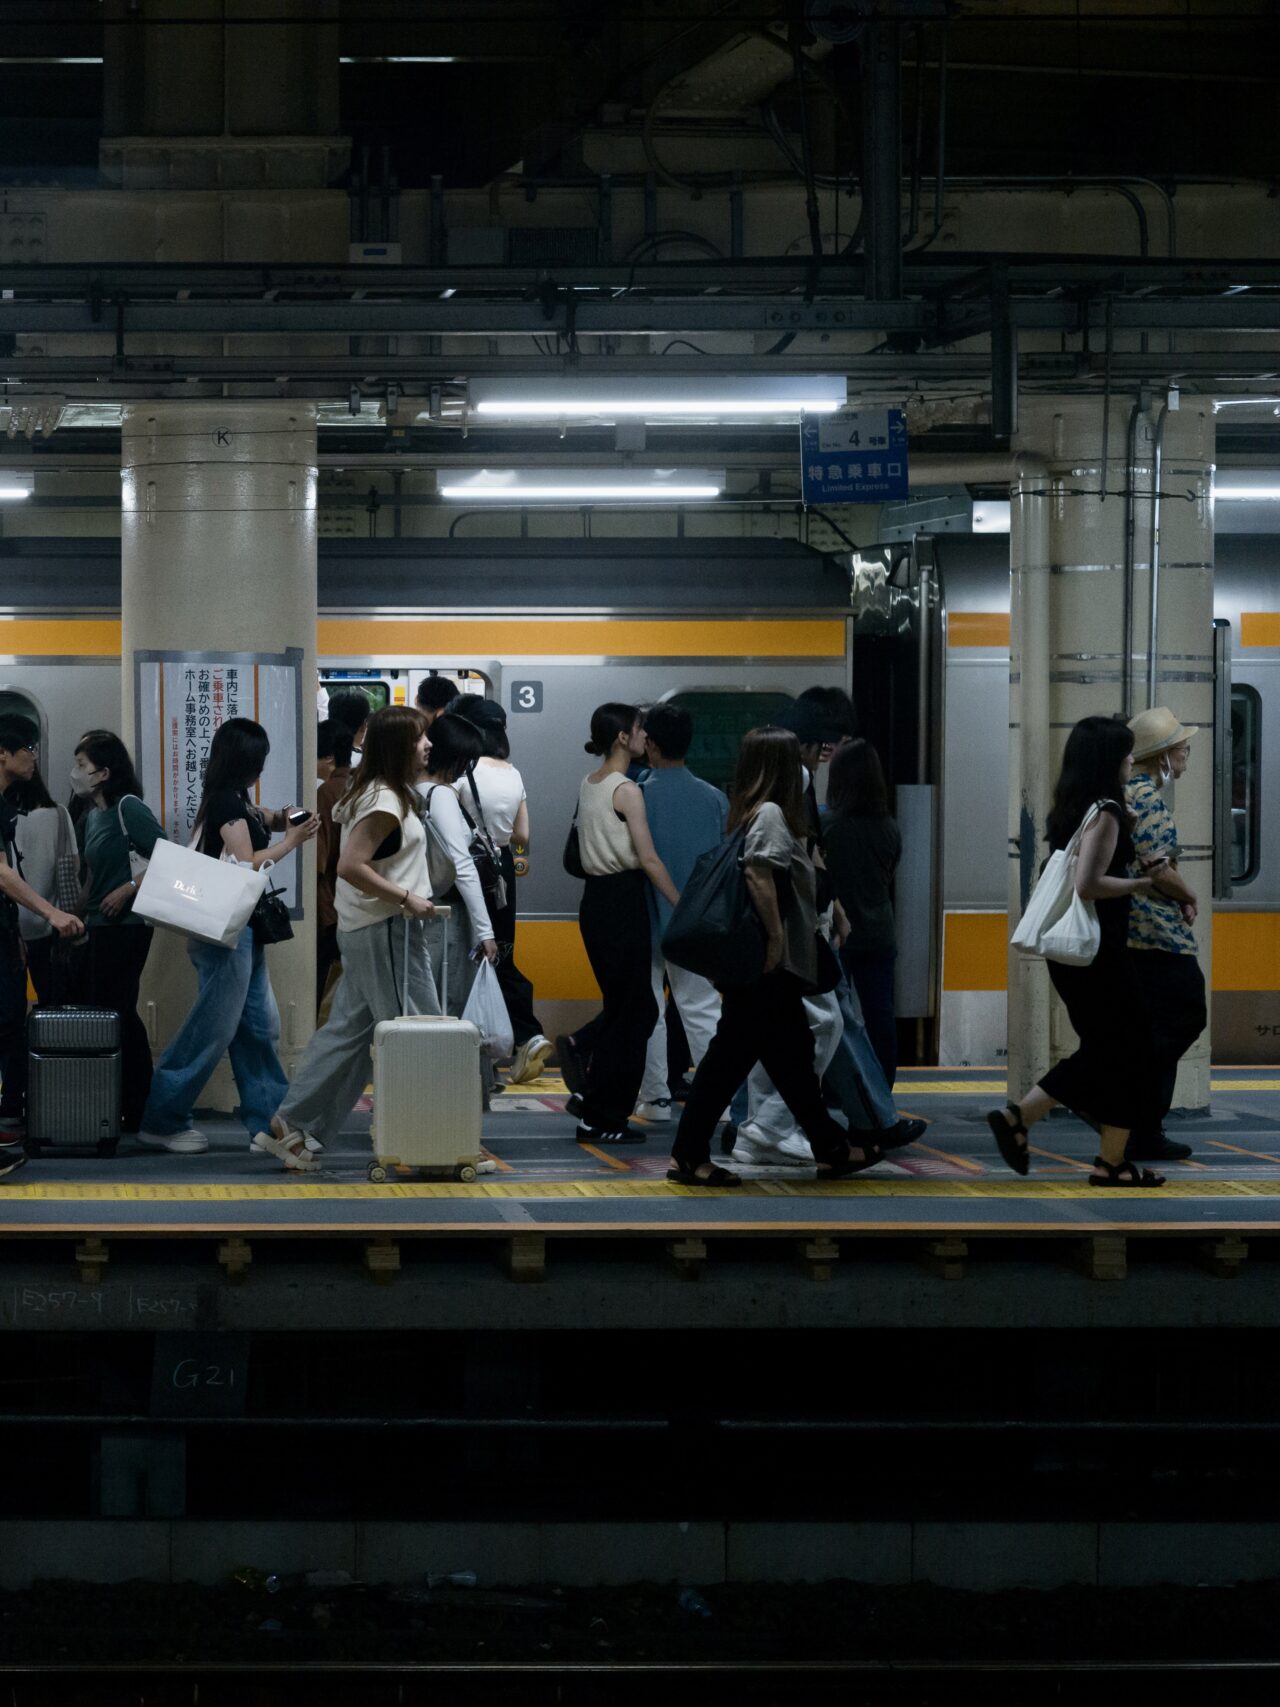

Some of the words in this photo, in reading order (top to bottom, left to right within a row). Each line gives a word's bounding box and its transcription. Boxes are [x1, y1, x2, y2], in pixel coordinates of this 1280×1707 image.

[217, 430, 230, 446] K
[848, 429, 861, 447] 4
[807, 462, 902, 482] 特急乗車口
[821, 482, 854, 493] Limited
[855, 481, 890, 492] Express
[212, 669, 225, 733] ご乗車され
[226, 668, 238, 720] 車内に落
[518, 685, 536, 709] 3
[184, 669, 197, 830] ホーム事務室へお越しください
[173, 1358, 235, 1389] G21
